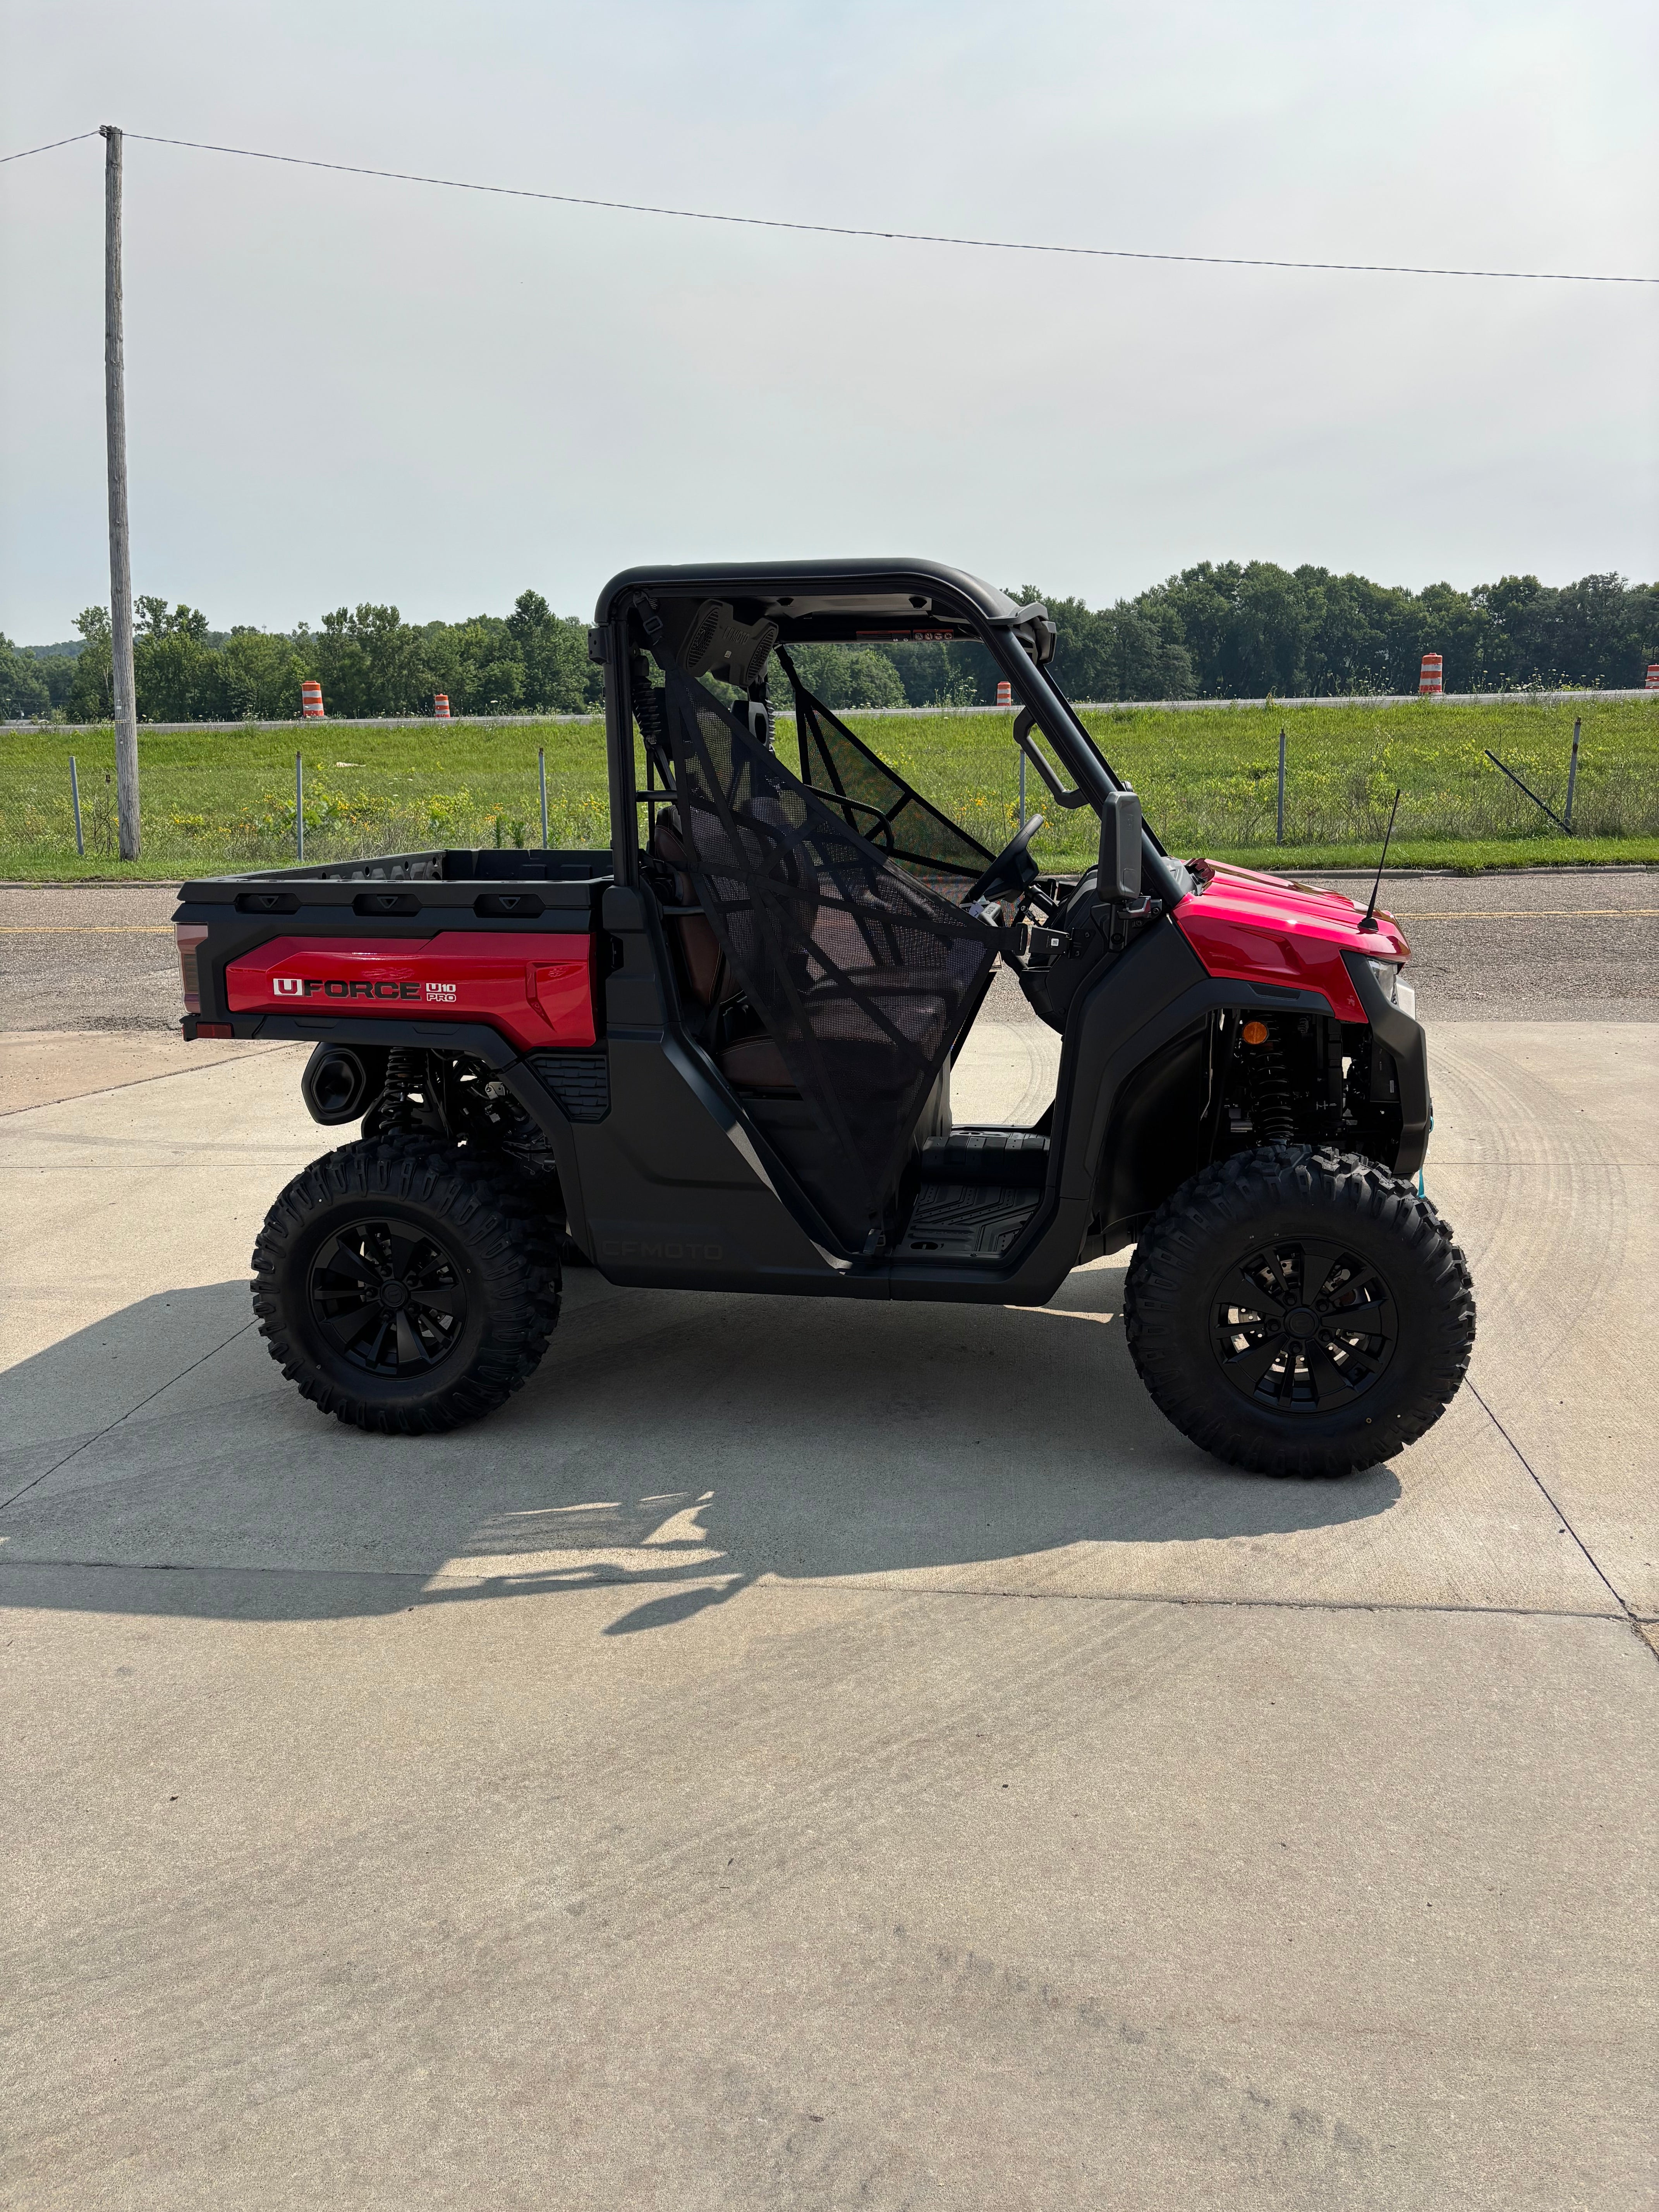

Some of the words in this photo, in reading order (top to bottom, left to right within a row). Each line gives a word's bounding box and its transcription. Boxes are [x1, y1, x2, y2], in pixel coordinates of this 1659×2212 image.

[426, 983, 456, 992] U10
[427, 993, 456, 1002] PRO
[601, 1240, 723, 1260] CFMOTO
